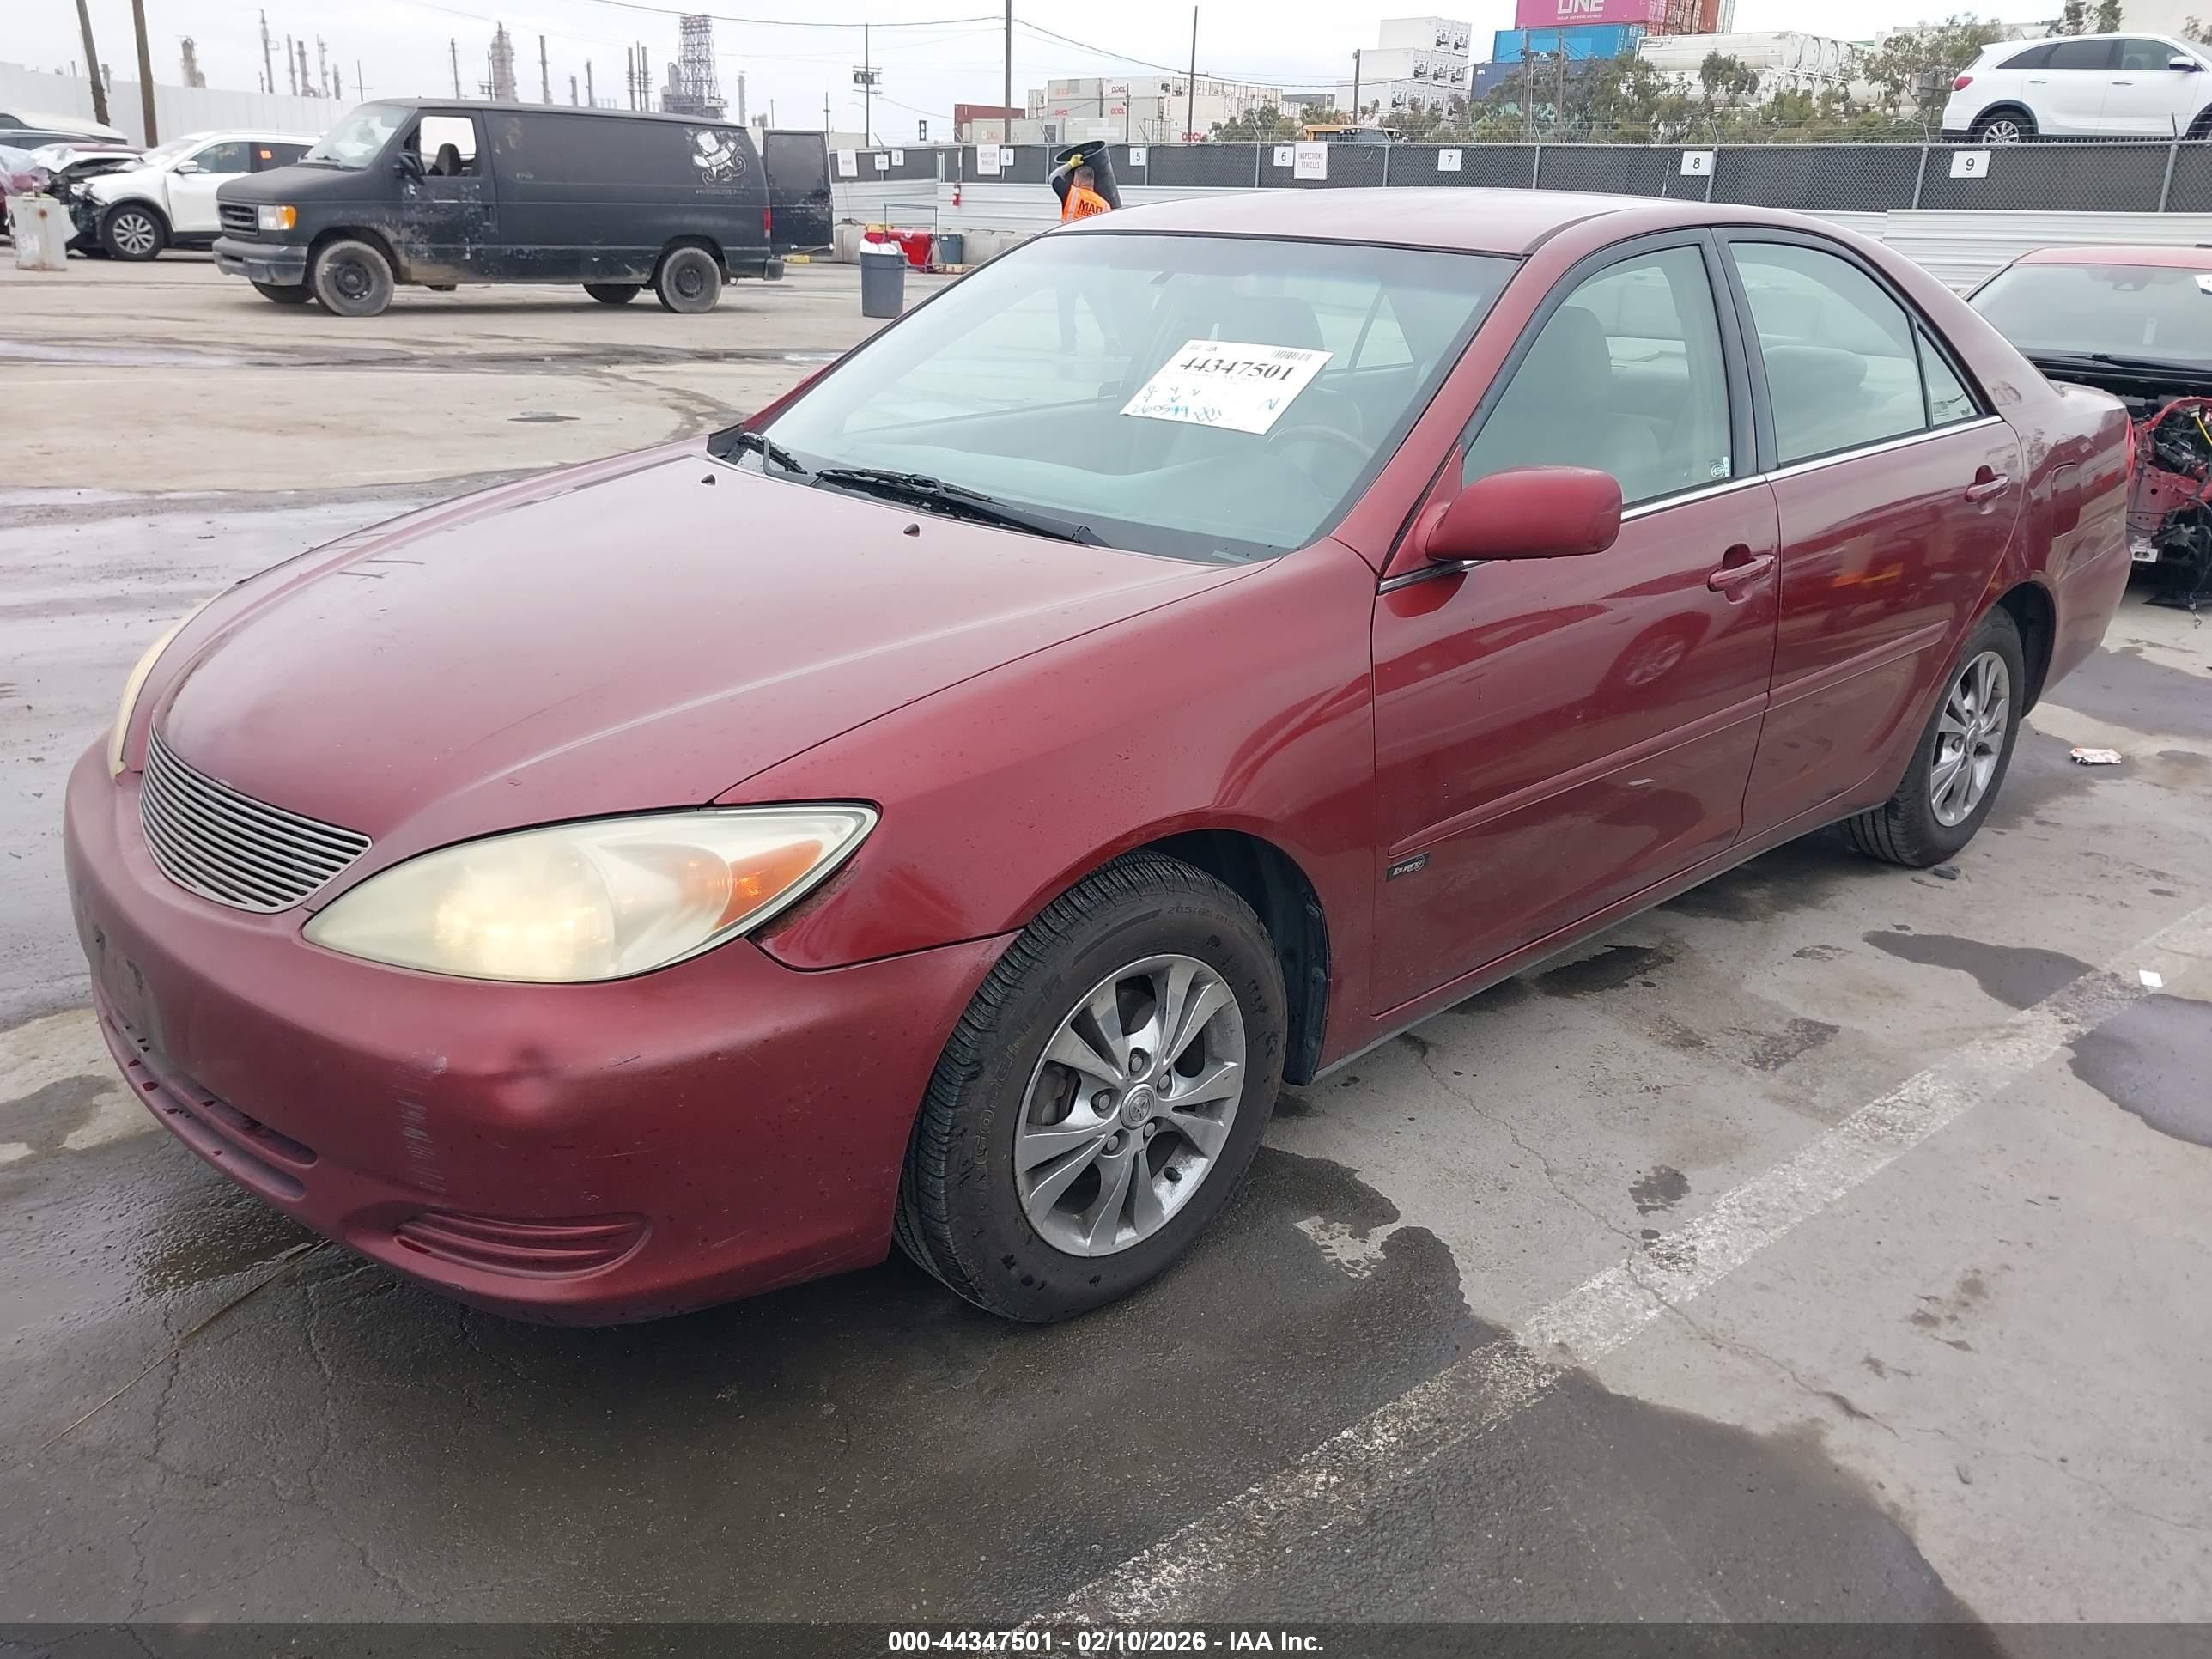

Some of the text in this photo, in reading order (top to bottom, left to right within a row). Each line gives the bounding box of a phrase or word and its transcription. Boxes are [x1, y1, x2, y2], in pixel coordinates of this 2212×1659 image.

[1136, 151, 1141, 161] 5
[1281, 151, 1287, 162] 6
[1447, 155, 1454, 166] 7
[1692, 157, 1701, 170] 8
[1965, 157, 1975, 172] 9
[1180, 356, 1295, 380] 44347501
